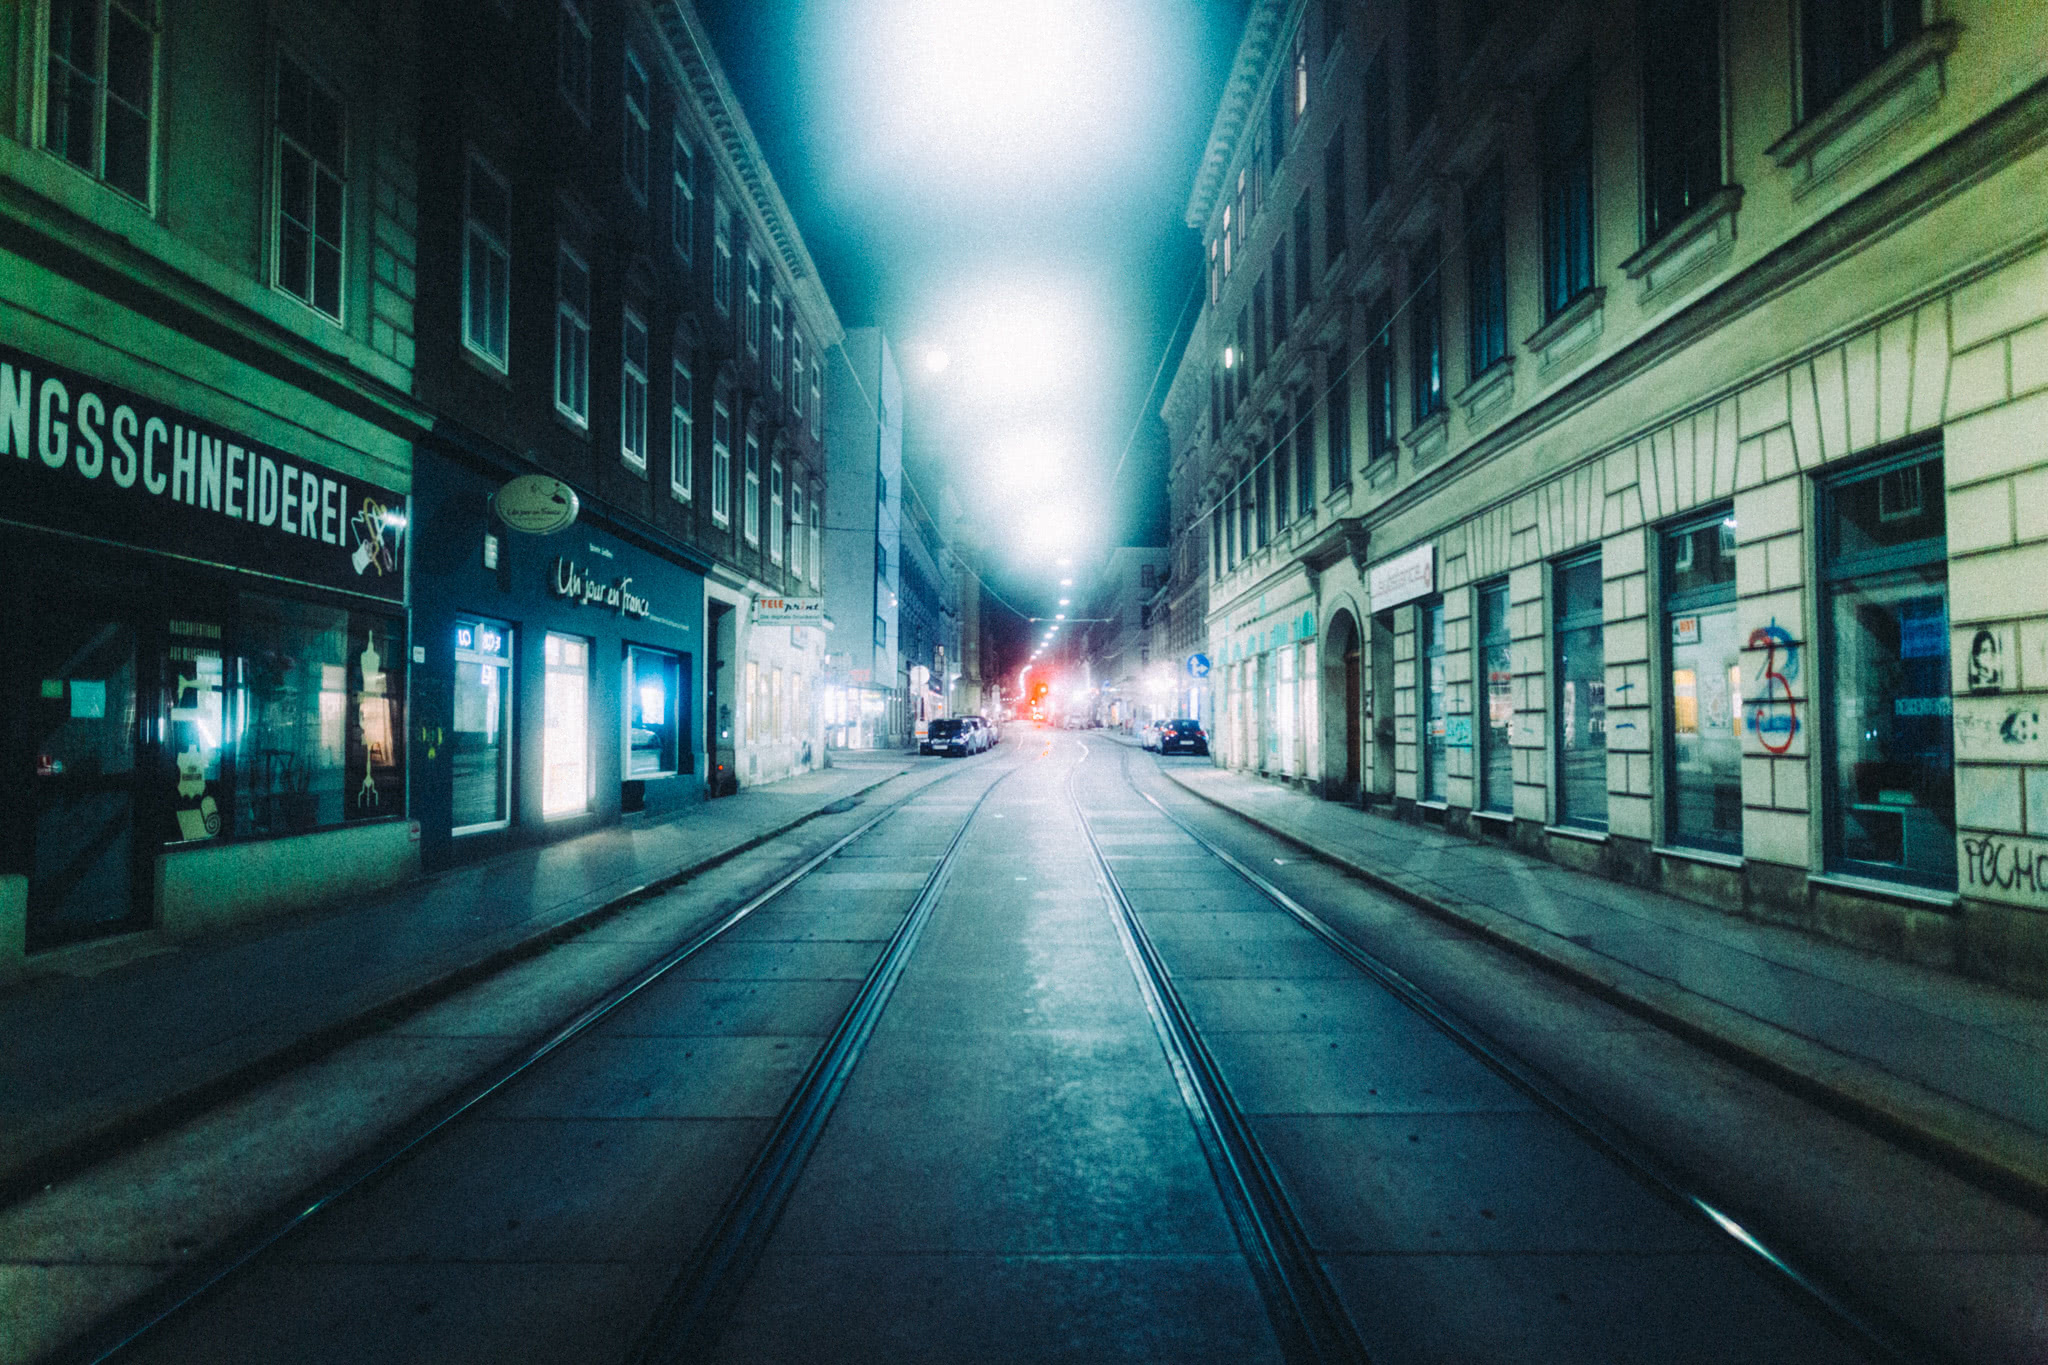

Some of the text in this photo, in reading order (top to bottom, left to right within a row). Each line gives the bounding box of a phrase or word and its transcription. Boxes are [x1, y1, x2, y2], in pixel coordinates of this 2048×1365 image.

[0, 362, 347, 547] NGSSCHNEIDEREI
[558, 556, 650, 616] Un jour en France
